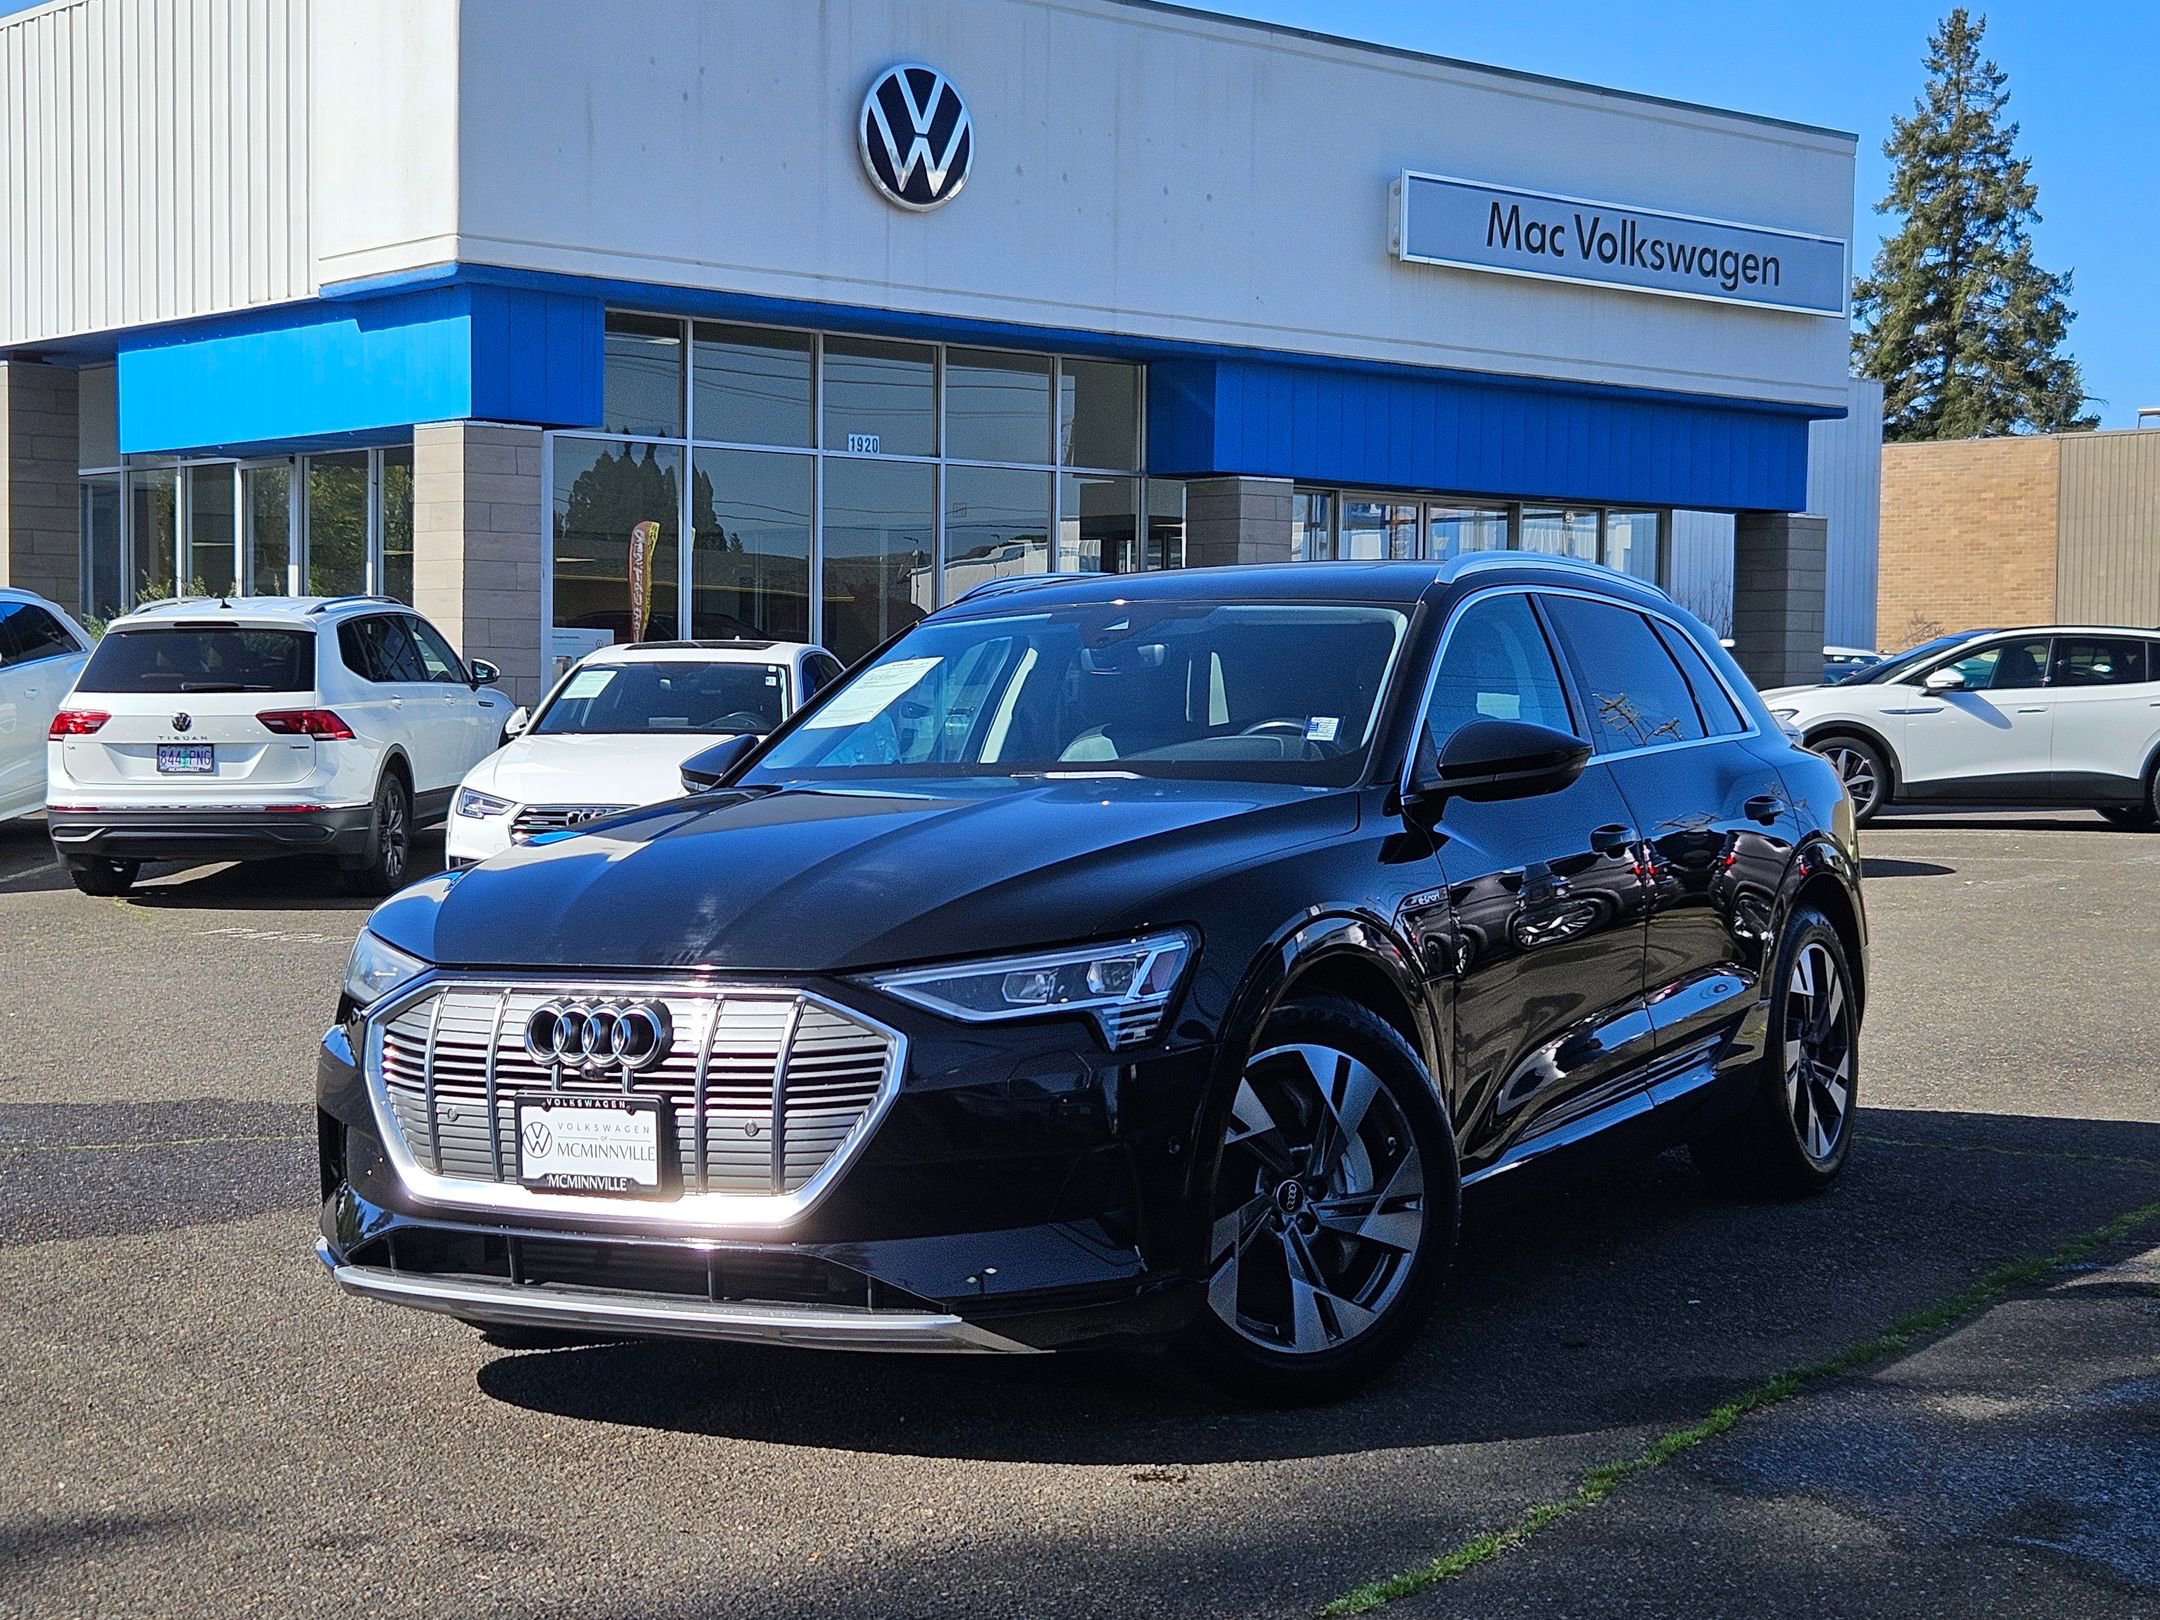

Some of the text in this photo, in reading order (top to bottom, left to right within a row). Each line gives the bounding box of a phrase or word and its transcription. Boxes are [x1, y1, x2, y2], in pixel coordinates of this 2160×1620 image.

[860, 64, 974, 211] VW
[1486, 201, 1780, 292] Mac Volkswagen
[850, 436, 879, 453] 1920
[160, 750, 211, 766] 844 PNG
[546, 1097, 626, 1109] VOLKSWAGEN
[557, 1121, 650, 1134] VOLKSWAGEN
[523, 1121, 552, 1158] VW
[557, 1142, 656, 1162] MCMINNVILLE
[547, 1174, 628, 1192] MCMINNVILLE
